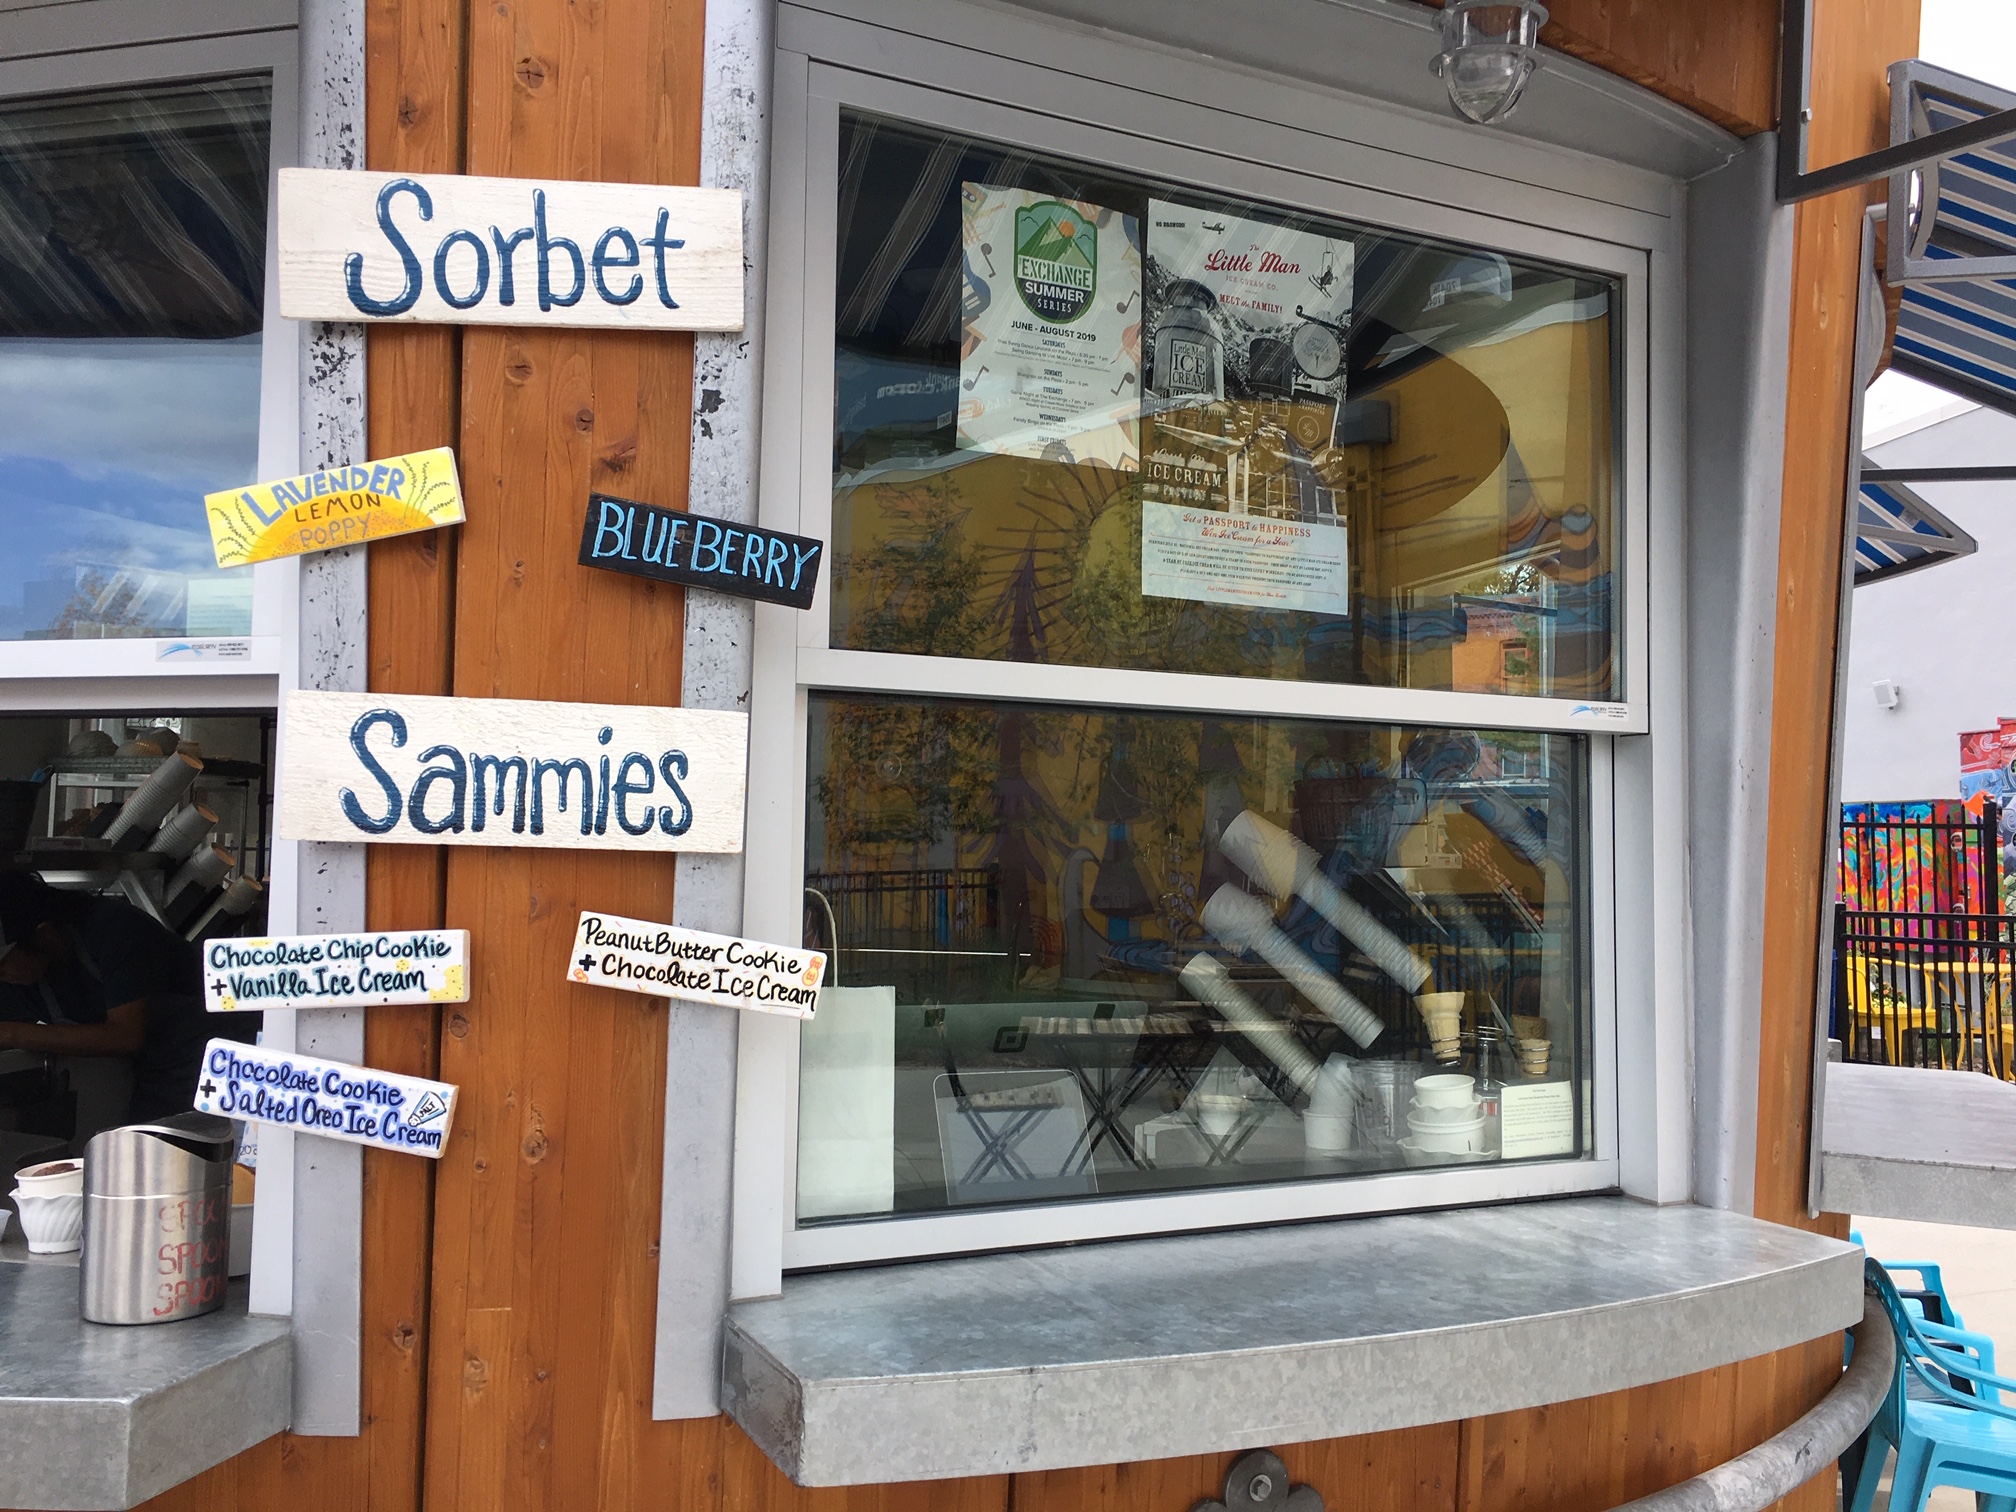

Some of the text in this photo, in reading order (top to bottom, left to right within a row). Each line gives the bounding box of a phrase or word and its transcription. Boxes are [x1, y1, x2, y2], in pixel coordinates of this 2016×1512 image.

[344, 178, 686, 317] Sorbet
[1022, 258, 1092, 288] EXCHANGE
[1205, 249, 1301, 274] Little Man
[1025, 281, 1084, 303] SUMMER
[1226, 275, 1237, 283] ICE
[1240, 276, 1264, 289] CREAM
[1037, 298, 1072, 313] SERIES
[1219, 294, 1240, 306] MEET
[1252, 300, 1282, 314] FAMILY!
[1011, 320, 1032, 332] JUNE
[1040, 326, 1074, 338] AUGUST
[1076, 332, 1096, 341] 2019
[1173, 354, 1205, 376] ICE
[1173, 371, 1205, 388] CREAM
[1300, 398, 1326, 409] PASSPORT
[1148, 463, 1222, 488] ICE CREAM
[241, 464, 405, 527] LAVENDER
[294, 493, 381, 522] LEMON
[300, 512, 371, 548] POPPY
[1183, 513, 1196, 522] Get
[1204, 516, 1250, 531] PASSPORT
[1260, 523, 1311, 538] HAPPINESS
[1202, 527, 1216, 536] Win
[1219, 530, 1231, 539] Ice
[1232, 531, 1253, 542] Cream
[1273, 536, 1294, 547] Year!
[338, 707, 693, 836] Sammies
[210, 936, 451, 969] Chocolate Chip Cookie
[727, 942, 801, 974] Cookie
[229, 970, 312, 999] Vanilla
[314, 966, 355, 996] Ice
[358, 968, 429, 993] Cream
[602, 953, 711, 990] Chocolate
[712, 969, 754, 997] Ice
[757, 975, 817, 1011] Cream
[210, 1050, 404, 1106] Chocolate Cookie
[219, 1081, 297, 1122] Salted
[302, 1098, 343, 1128] Oreo
[344, 1105, 378, 1137] Ice
[382, 1111, 442, 1149] Cream
[419, 1101, 436, 1117] SALT
